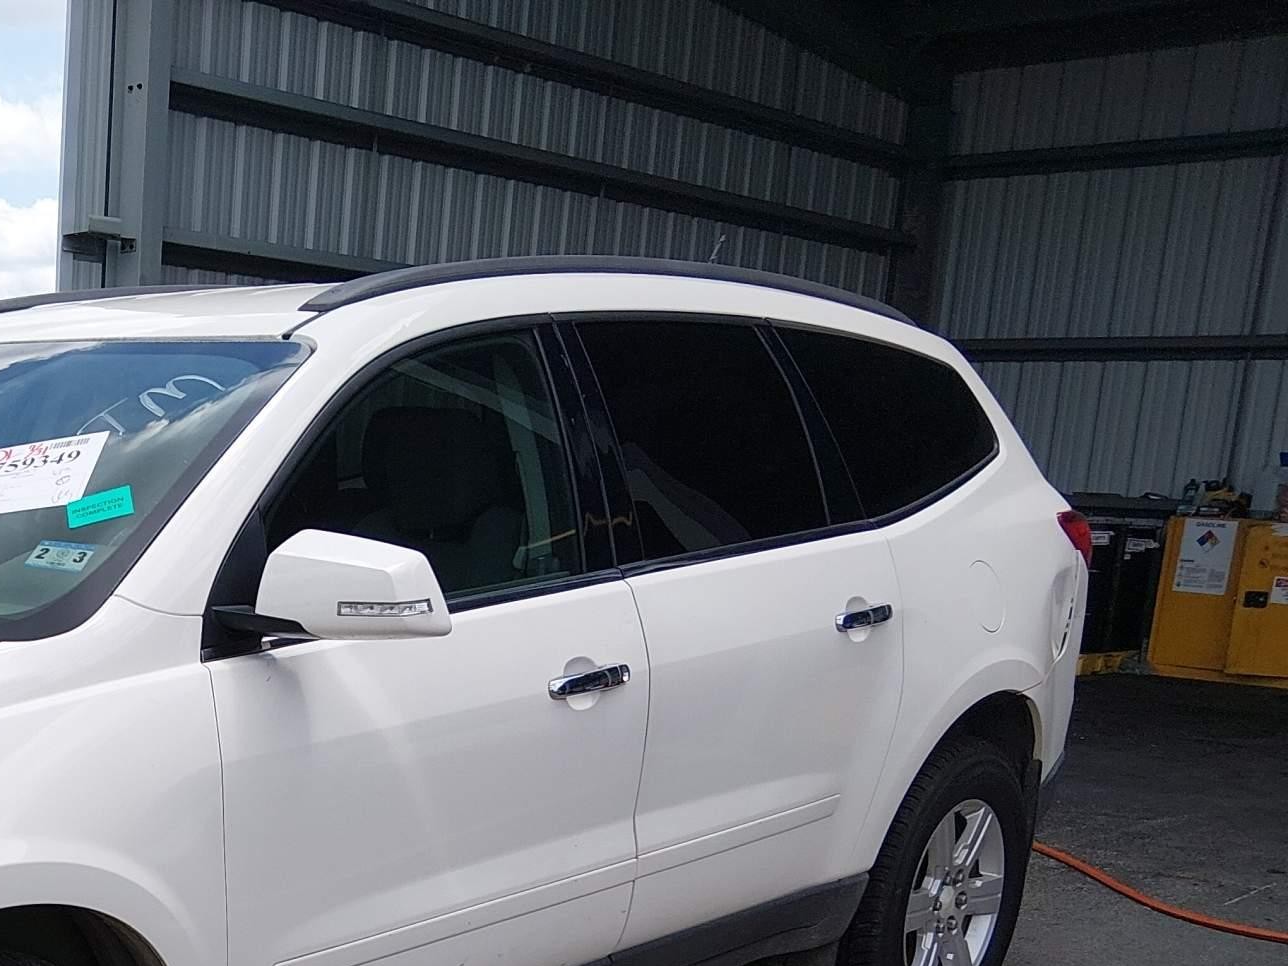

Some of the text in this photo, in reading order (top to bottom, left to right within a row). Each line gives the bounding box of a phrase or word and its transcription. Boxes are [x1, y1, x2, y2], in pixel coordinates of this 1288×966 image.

[72, 496, 124, 515] INSPECTION
[76, 502, 123, 519] COMPLETE
[34, 547, 51, 560] 2
[72, 551, 88, 563] 3
